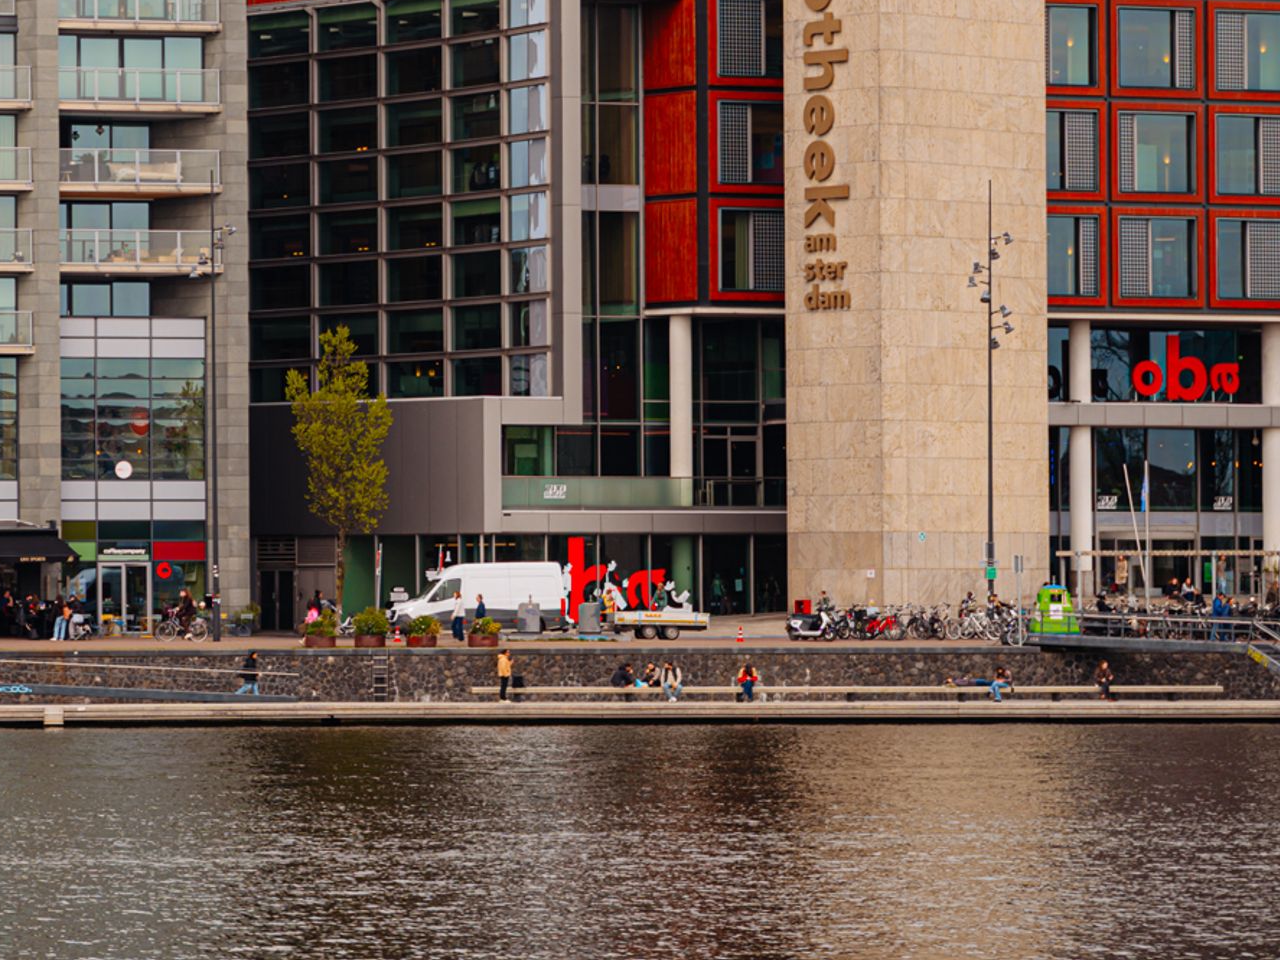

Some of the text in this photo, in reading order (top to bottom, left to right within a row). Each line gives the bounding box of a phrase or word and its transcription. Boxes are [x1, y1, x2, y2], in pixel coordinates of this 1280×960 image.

[804, 233, 837, 253] am
[803, 258, 848, 283] ster
[803, 283, 851, 311] dam
[1132, 334, 1240, 401] oba
